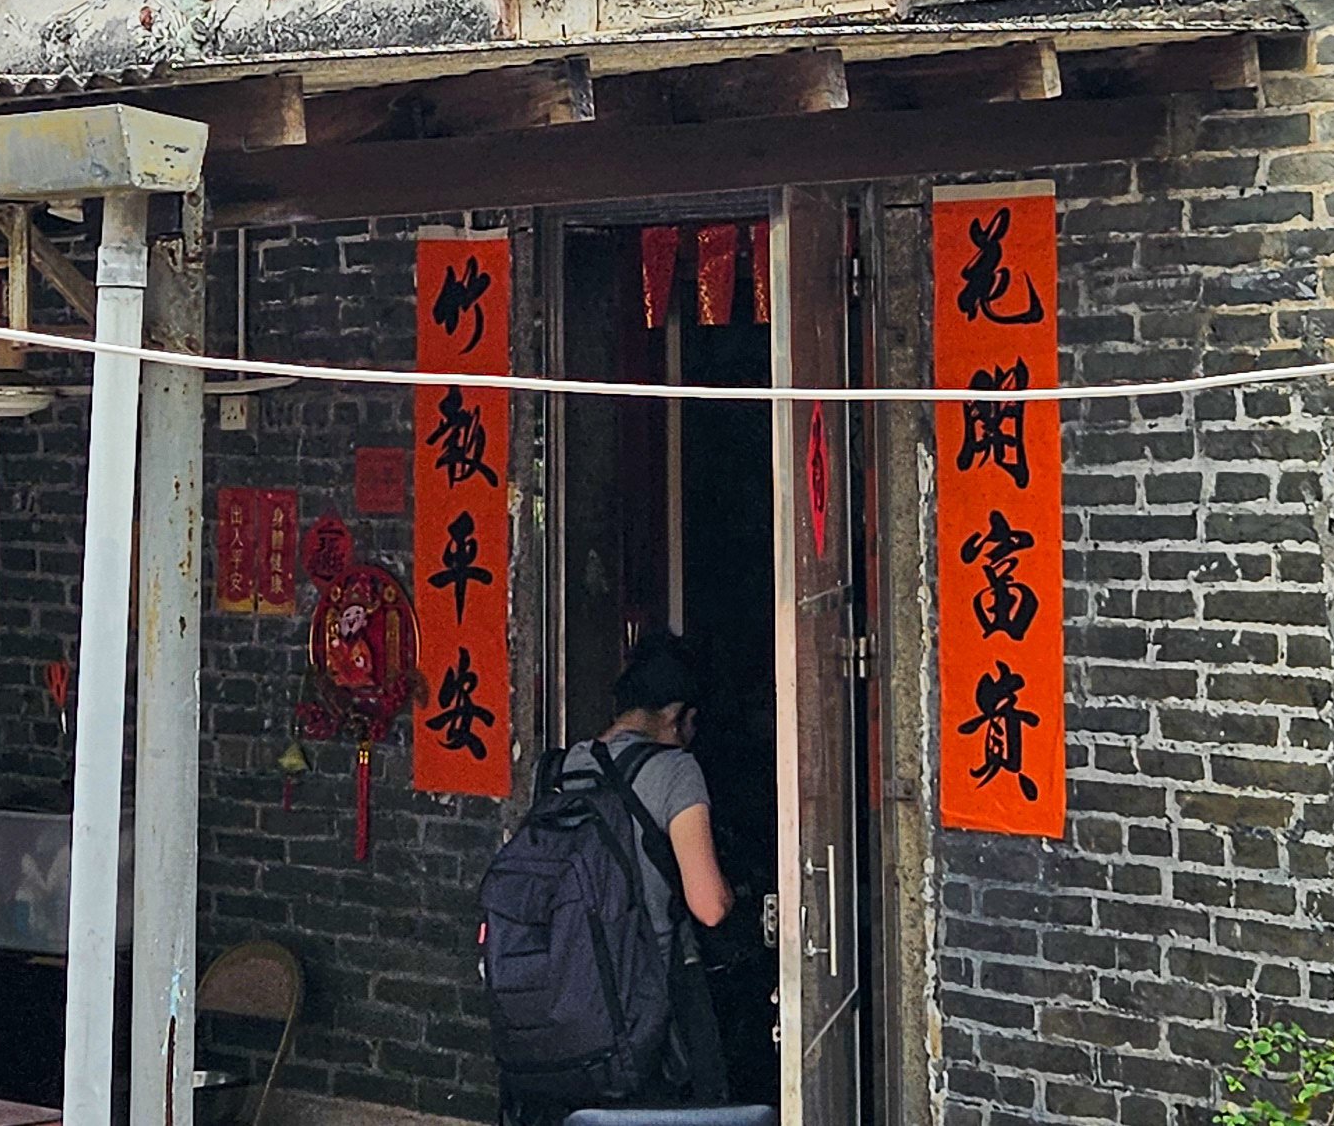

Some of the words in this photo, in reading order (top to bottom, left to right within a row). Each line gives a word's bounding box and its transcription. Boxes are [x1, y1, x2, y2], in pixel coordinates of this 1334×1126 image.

[230, 504, 243, 592] 出入平安
[425, 255, 499, 761] 竹報平安
[957, 207, 1044, 802] 花開富貴
